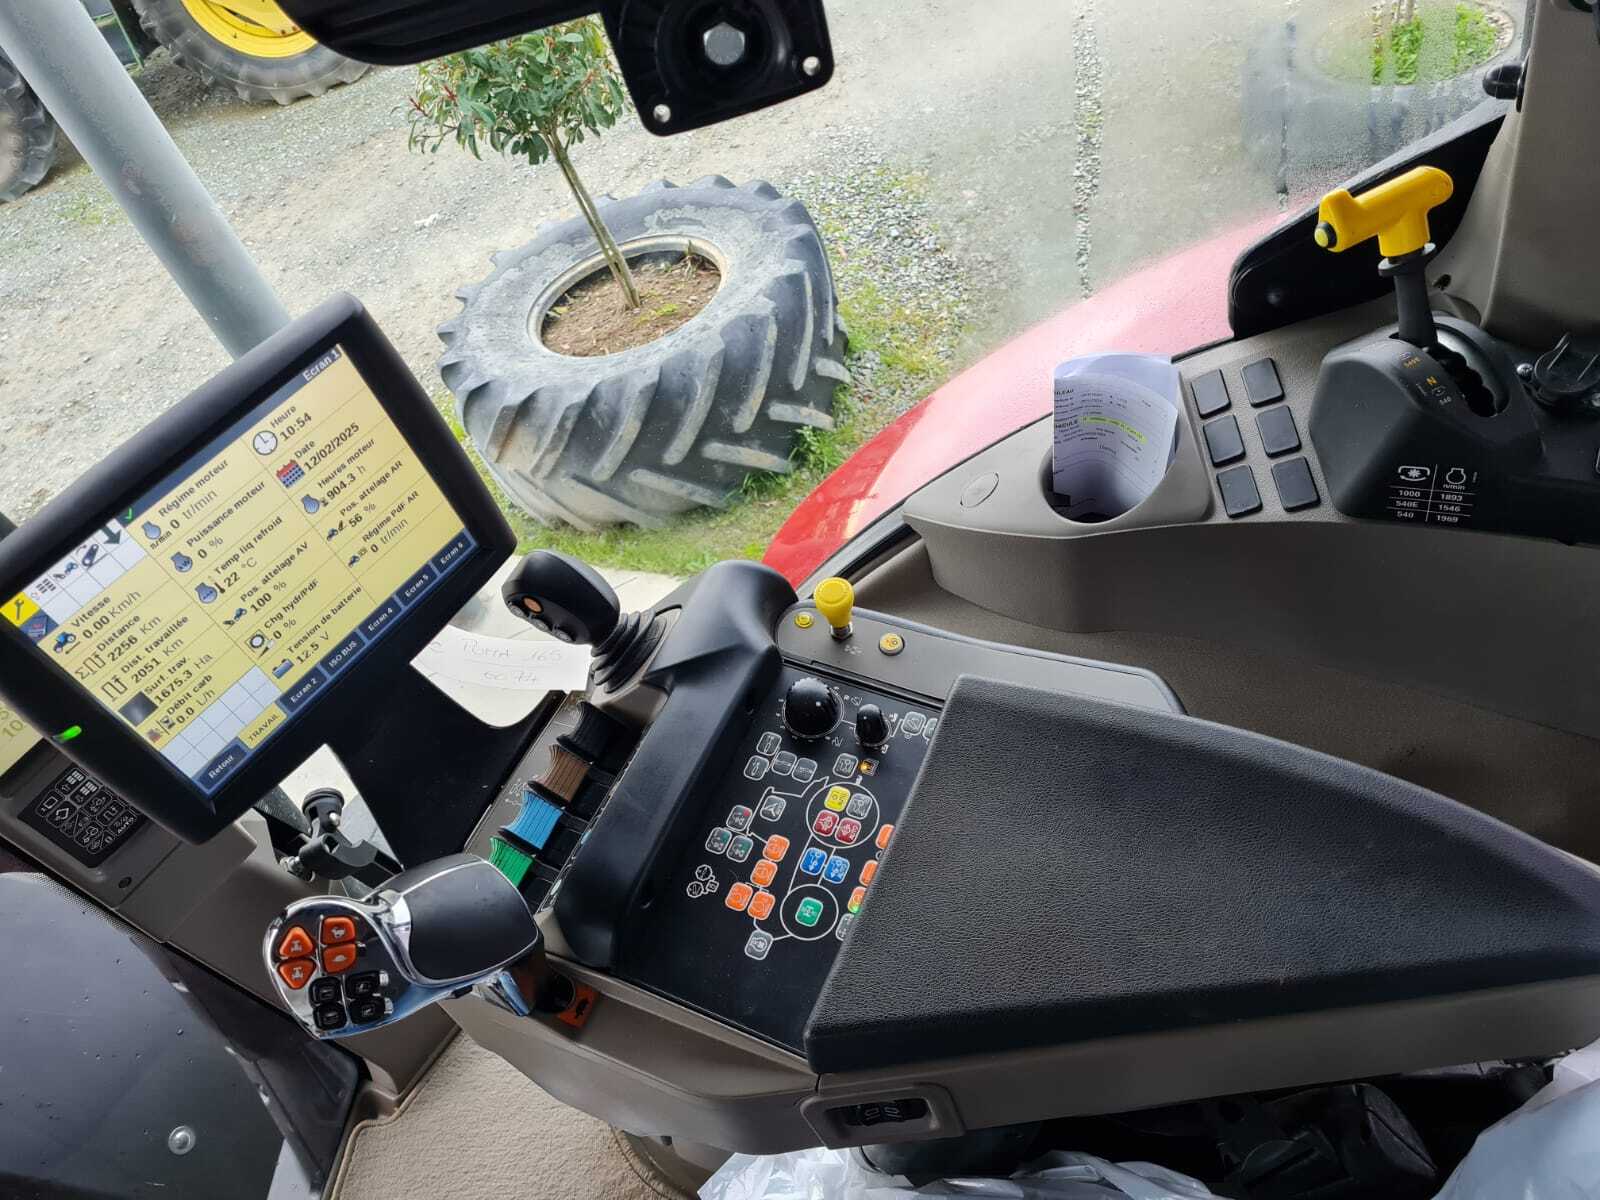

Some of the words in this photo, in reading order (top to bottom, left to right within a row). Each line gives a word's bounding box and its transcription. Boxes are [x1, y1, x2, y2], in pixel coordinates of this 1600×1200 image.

[302, 356, 331, 381] Ecran
[331, 349, 339, 358] 1
[1426, 375, 1438, 386] N
[270, 405, 296, 428] Heure
[279, 412, 311, 440] 10:54
[294, 440, 315, 458] Date
[303, 422, 359, 470] 12/02/2025
[317, 463, 346, 488] Heures
[346, 439, 374, 464] moteur
[158, 487, 194, 516] Régime
[194, 459, 228, 488] moteur
[326, 472, 356, 499] 904.3
[356, 465, 366, 474] h
[359, 472, 390, 500] attelage
[390, 460, 402, 473] AR
[170, 519, 180, 528] 0
[182, 490, 217, 519] tr/min
[1395, 500, 1418, 508] 540E
[1439, 504, 1461, 513] 1546
[1399, 490, 1420, 498] 1000
[1441, 493, 1463, 502] 1893
[186, 508, 233, 546] Puissance
[233, 481, 264, 509] moteur
[348, 513, 362, 527] 56
[363, 503, 376, 512] %
[362, 516, 391, 542] Régime
[390, 503, 404, 517] PdF
[407, 490, 418, 503] AR
[1396, 511, 1414, 519] 540
[1437, 514, 1459, 523] 1969
[197, 548, 207, 558] 0
[208, 536, 223, 548] %
[214, 553, 240, 574] Temp
[239, 541, 254, 553] liq
[253, 516, 282, 543] refroid
[370, 543, 378, 552] 0
[379, 519, 408, 544] tr/min
[261, 554, 295, 584] attelage
[296, 541, 307, 555] AV
[440, 547, 458, 563] Ecran
[223, 571, 240, 587] 22
[241, 556, 257, 568] °C
[250, 592, 271, 611] 100
[273, 581, 287, 591] %
[404, 579, 423, 596] Ecran
[71, 596, 110, 627] Vitesse
[82, 615, 110, 638] 0.00
[107, 591, 141, 618] Km/h
[264, 612, 283, 628] Chg
[287, 623, 320, 653] Tension
[320, 614, 331, 624] de
[330, 586, 361, 614] batterie
[368, 613, 387, 630] Ecran
[96, 615, 140, 651] Distance
[107, 635, 137, 661] 2256
[139, 616, 161, 634] Km
[144, 616, 187, 653] travaillée
[273, 630, 282, 639] 0
[282, 619, 296, 628] %
[131, 657, 160, 683] 2051
[162, 638, 183, 656] Km
[296, 642, 319, 662] 12.5
[319, 631, 328, 640] V
[329, 654, 342, 666] ISO
[341, 641, 356, 655] BUS
[154, 669, 192, 703] 1675.3
[193, 654, 213, 669] Ha
[290, 683, 311, 702] Ecran
[166, 692, 192, 715] Débit
[192, 674, 212, 692] carb
[176, 706, 194, 723] 0.0
[248, 714, 278, 741] TRAVAIL
[208, 755, 233, 778] Retour
